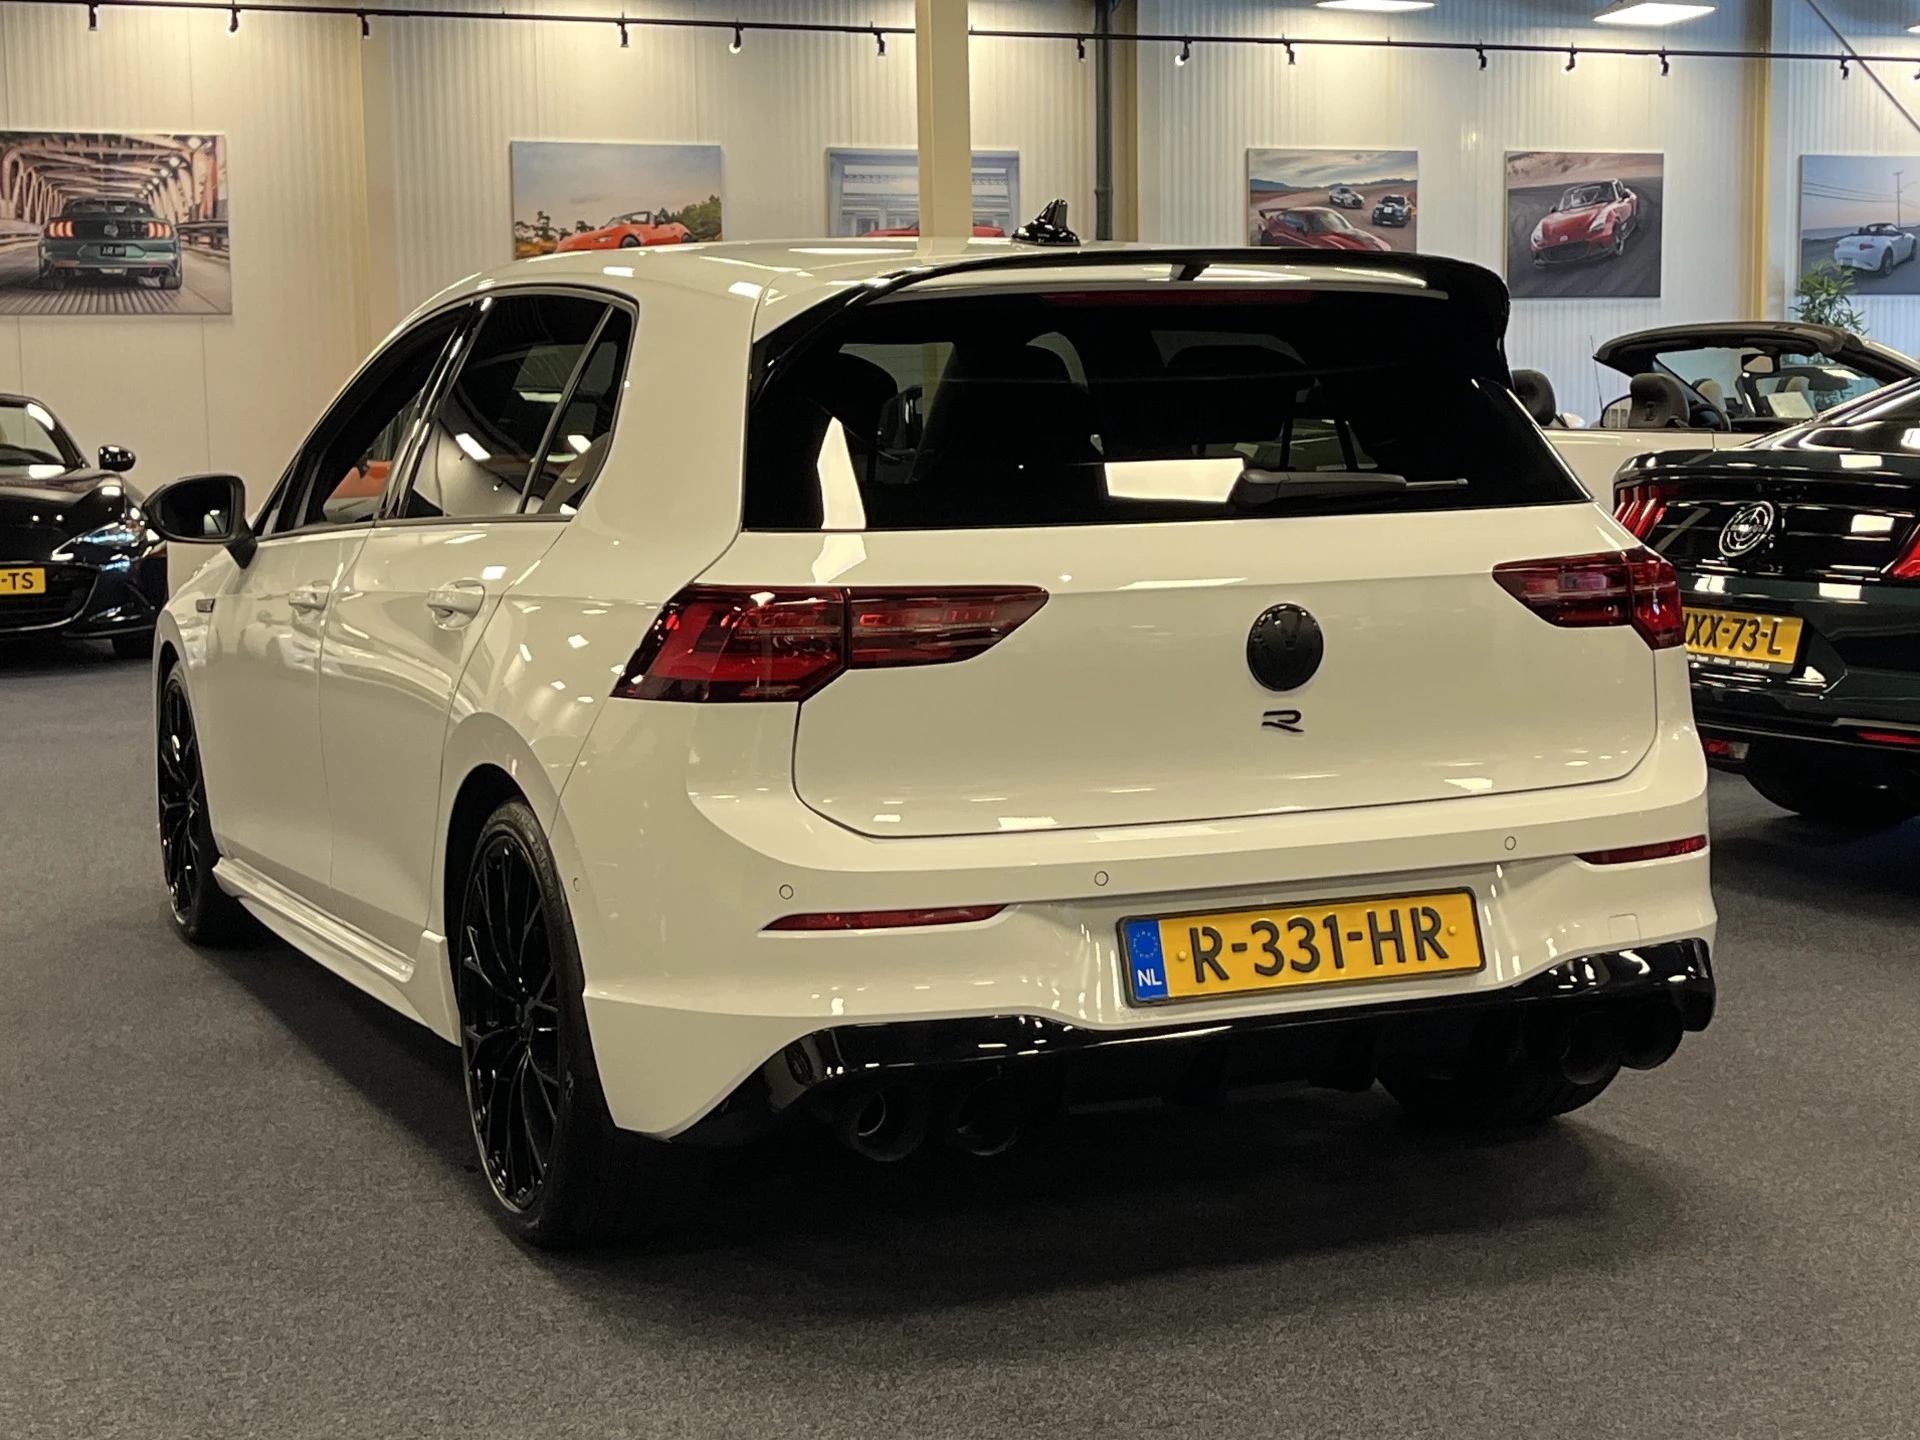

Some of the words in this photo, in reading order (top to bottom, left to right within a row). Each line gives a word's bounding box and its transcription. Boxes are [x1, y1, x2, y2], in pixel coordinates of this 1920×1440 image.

[1261, 709, 1304, 733] R
[1188, 905, 1449, 983] R-331-HR
[1137, 968, 1162, 987] NL
